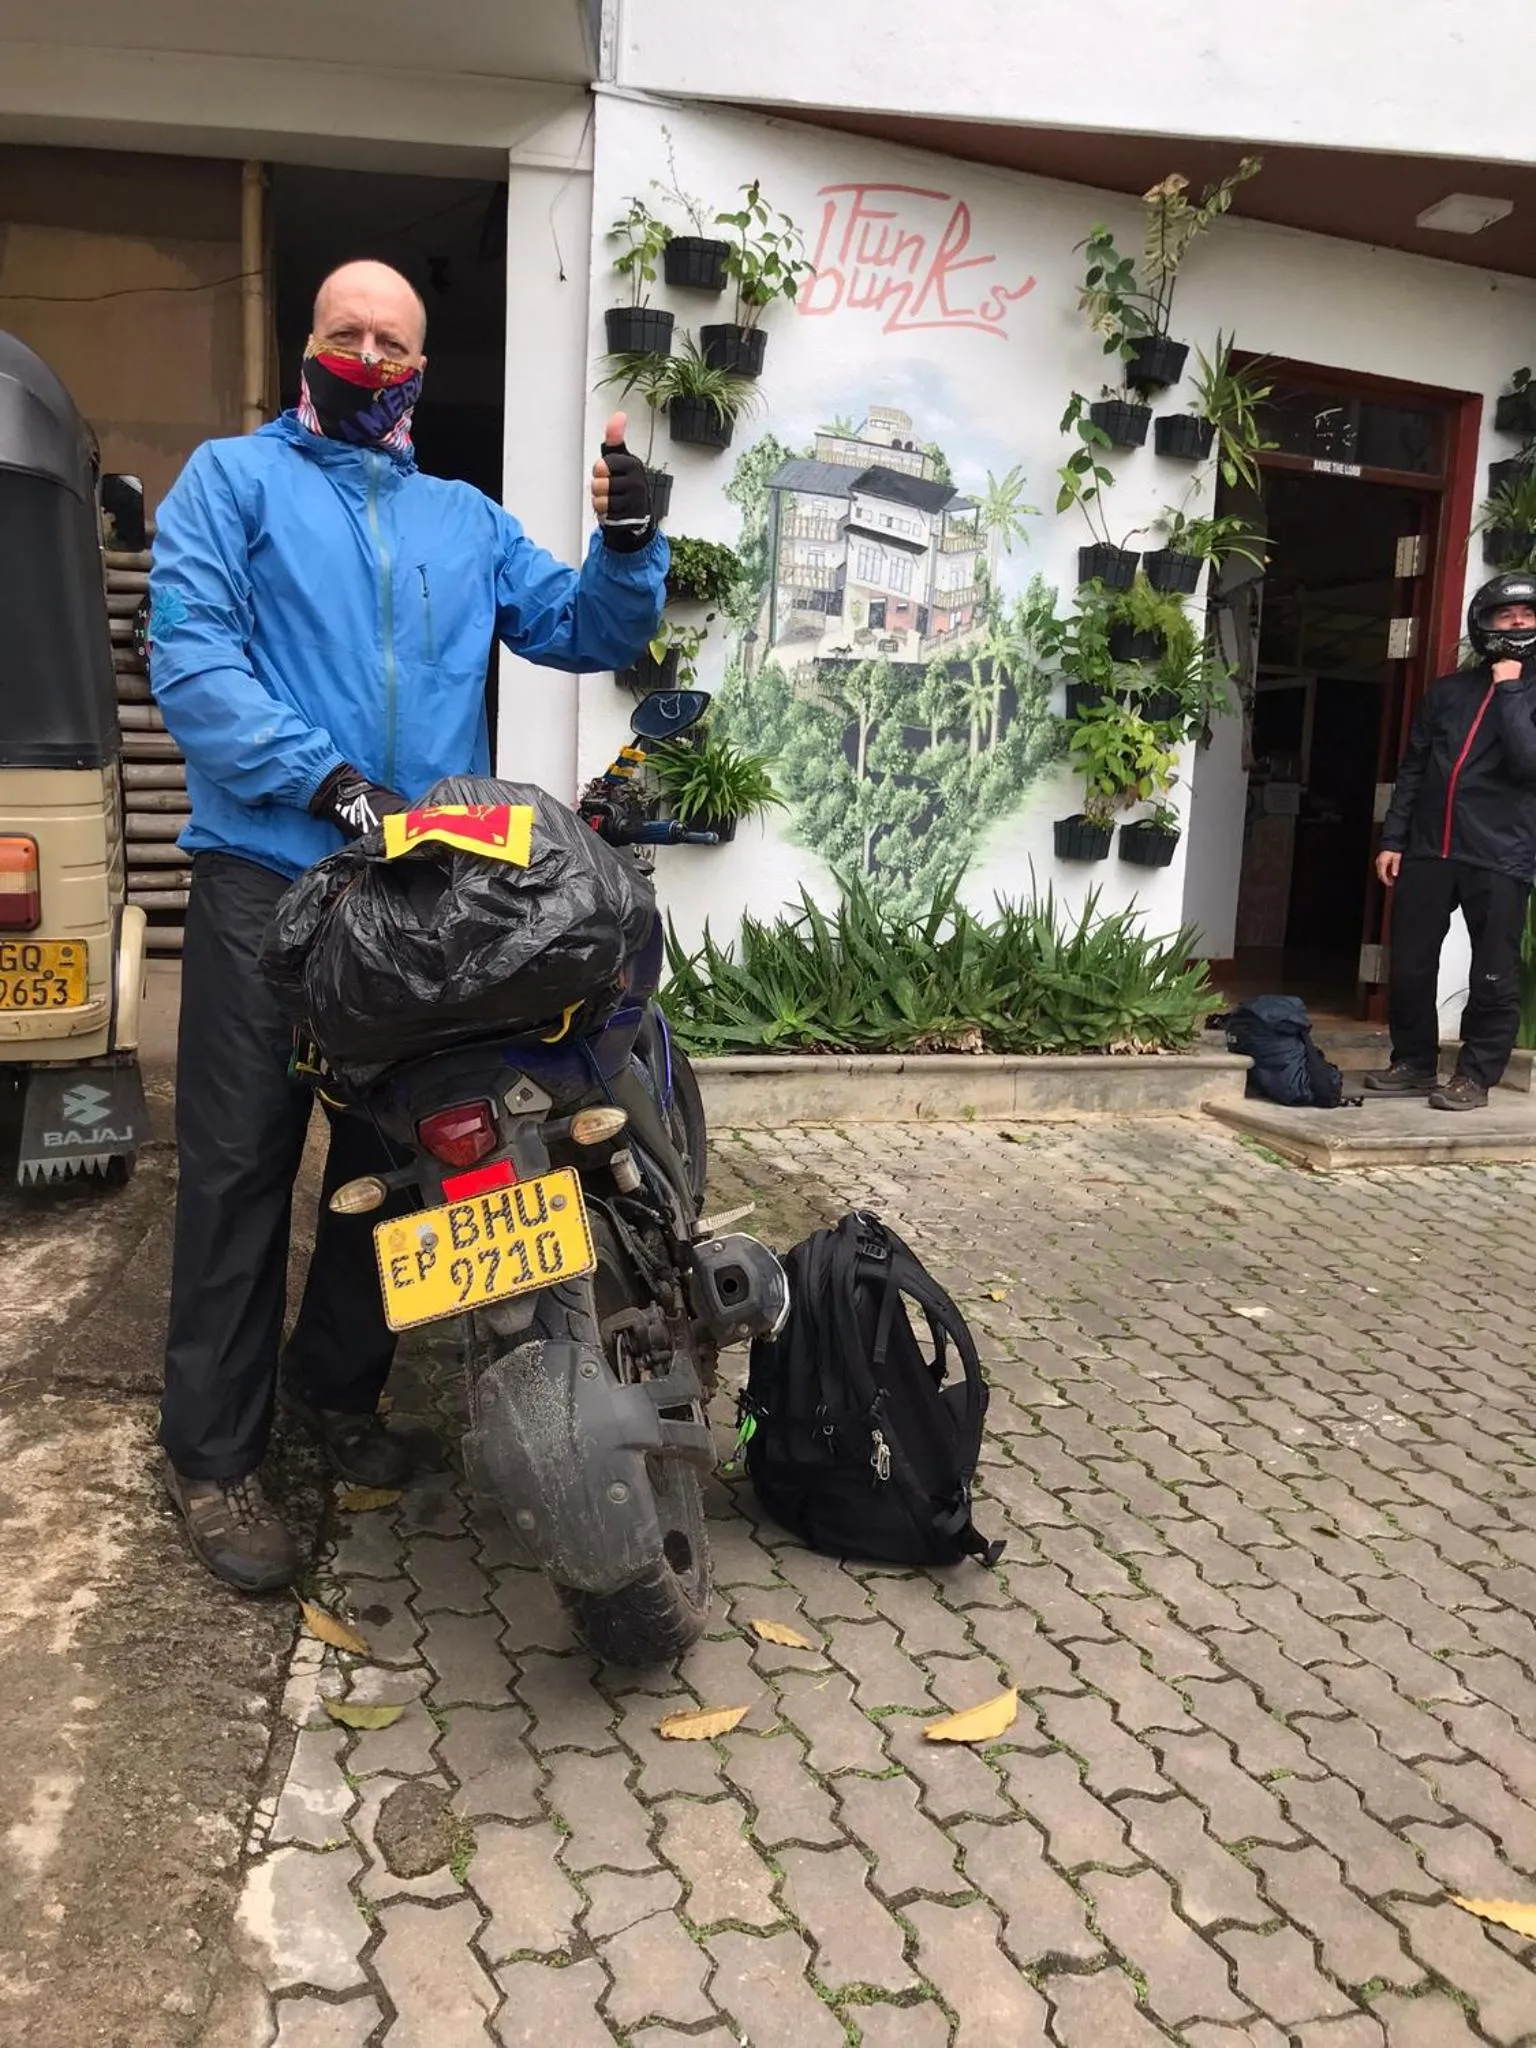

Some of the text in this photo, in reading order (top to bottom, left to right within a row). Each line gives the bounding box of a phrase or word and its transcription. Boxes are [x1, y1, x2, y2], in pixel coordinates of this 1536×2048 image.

[134, 628, 145, 639] 11
[43, 1125, 134, 1148] BAJAJ
[450, 1181, 549, 1251] BHU
[390, 1248, 437, 1289] EP
[450, 1230, 564, 1302] 9710
